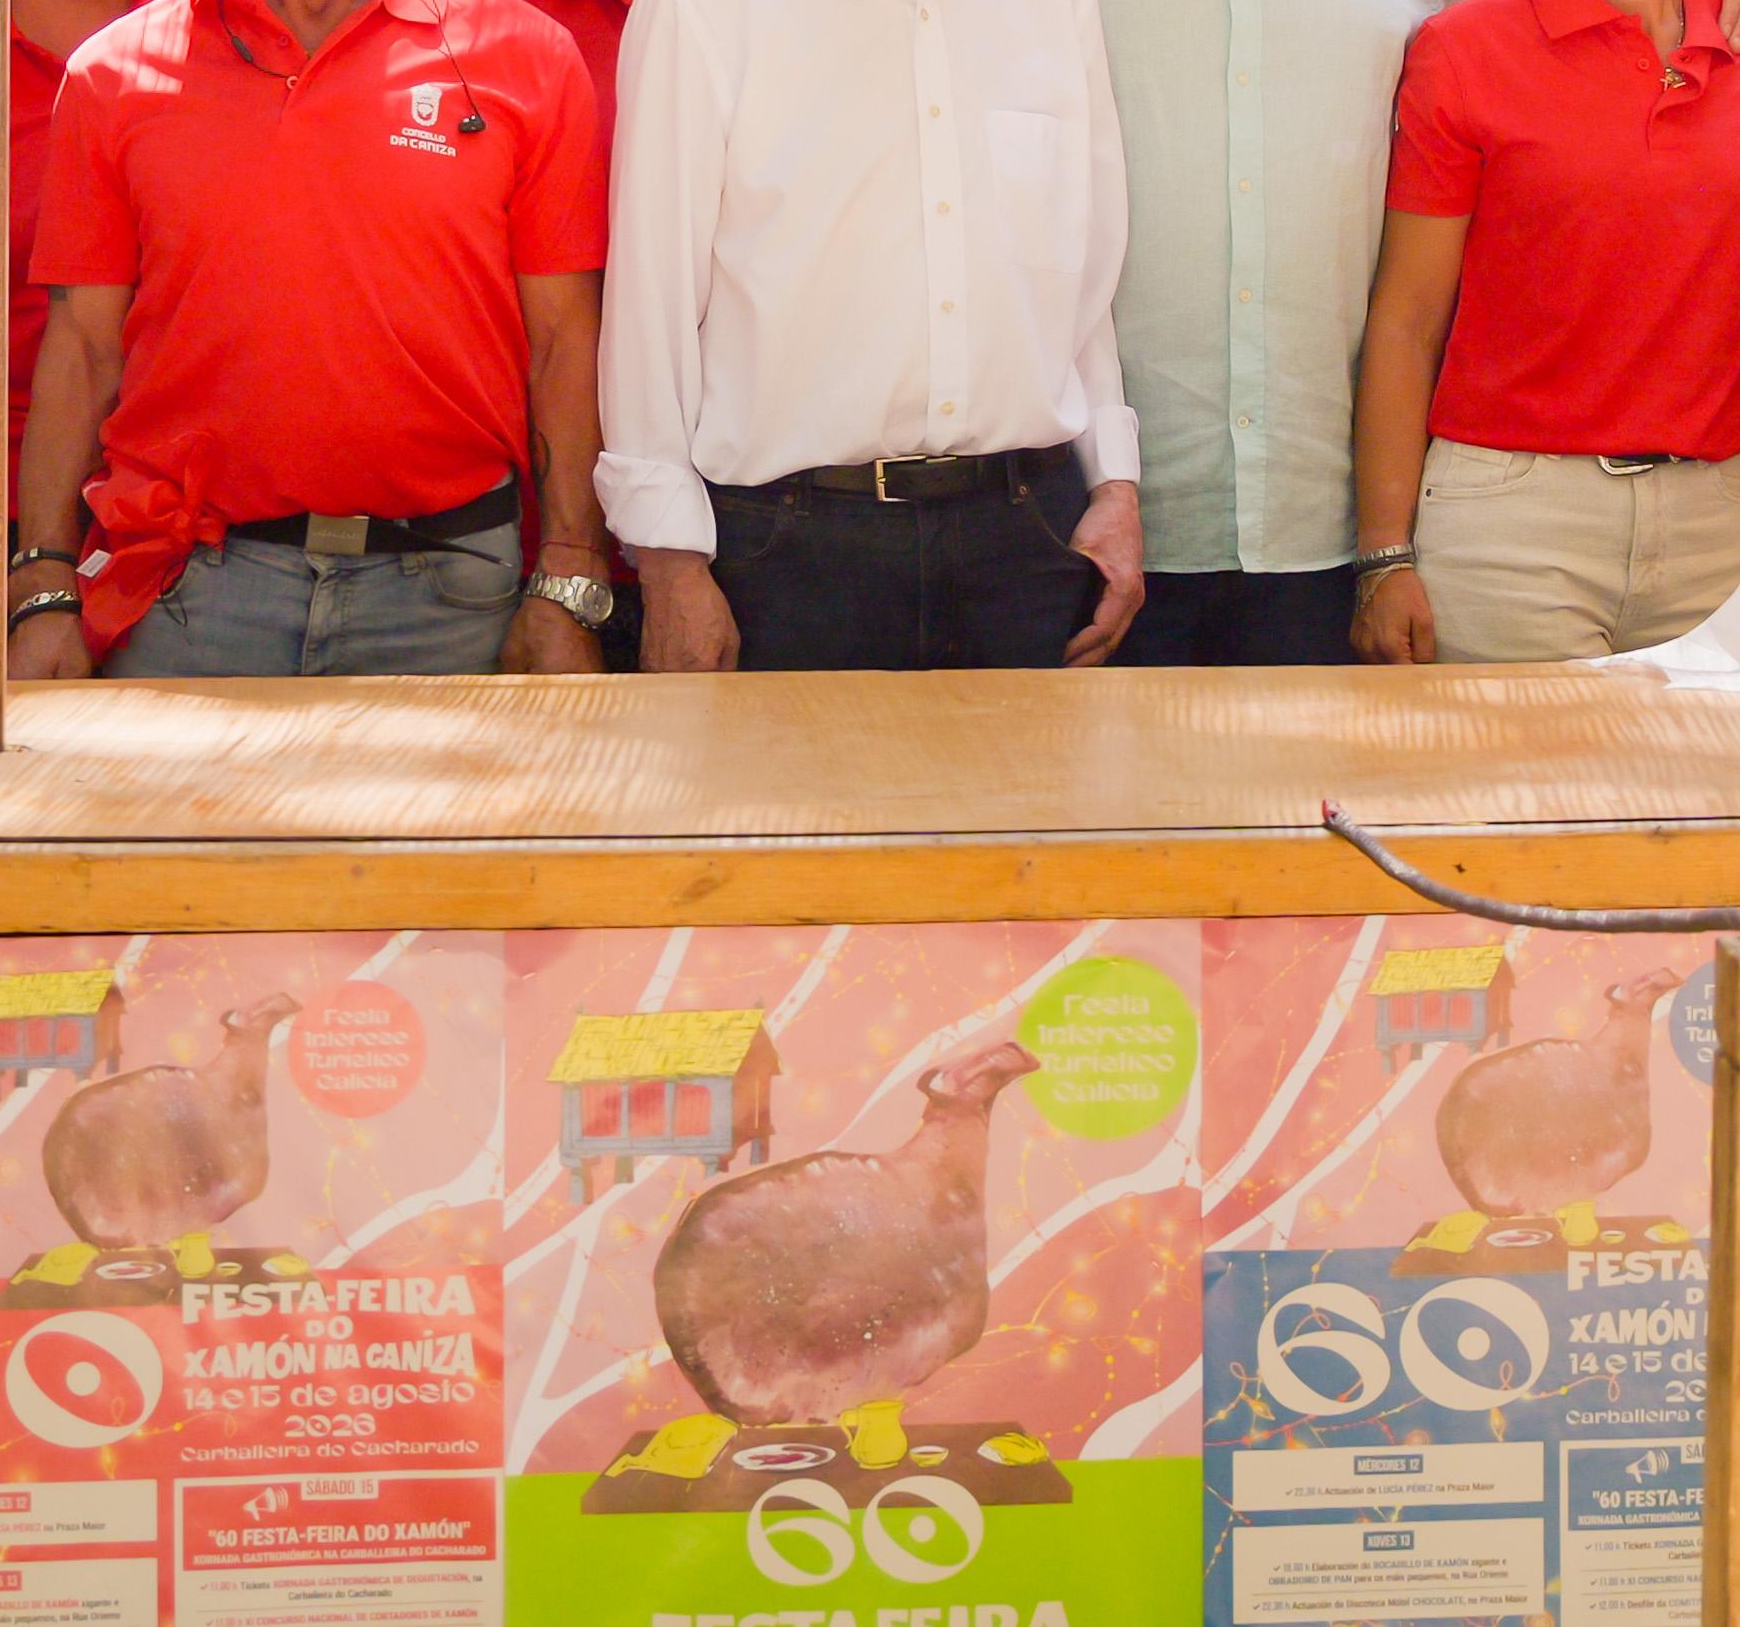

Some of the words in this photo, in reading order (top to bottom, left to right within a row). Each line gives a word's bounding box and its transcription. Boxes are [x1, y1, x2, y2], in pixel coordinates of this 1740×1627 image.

[390, 135, 408, 147] DA
[409, 139, 456, 157] CANIZA
[182, 1275, 476, 1324] FESTA-FEIRA
[306, 1316, 354, 1340] DO
[1569, 1301, 1695, 1346] XAMÓN
[184, 1334, 316, 1380] XAMÓN
[324, 1342, 360, 1370] NA
[1258, 1278, 1549, 1416] 60
[1569, 1353, 1599, 1375] 14
[1605, 1354, 1628, 1374] e
[1632, 1351, 1661, 1372] 15
[184, 1387, 216, 1410] 14
[222, 1388, 245, 1410] e
[251, 1385, 281, 1408] 15
[290, 1382, 337, 1407] de
[348, 1379, 475, 1409] agosto
[284, 1413, 376, 1438] 2026
[1566, 1408, 1689, 1425] Carballeira
[181, 1444, 310, 1462] Carballeira
[317, 1442, 345, 1457] do
[351, 1440, 479, 1456] Cacharado
[243, 1526, 359, 1547] FESTA-FEIRA
[365, 1524, 389, 1542] DO
[747, 1475, 984, 1586] 60
